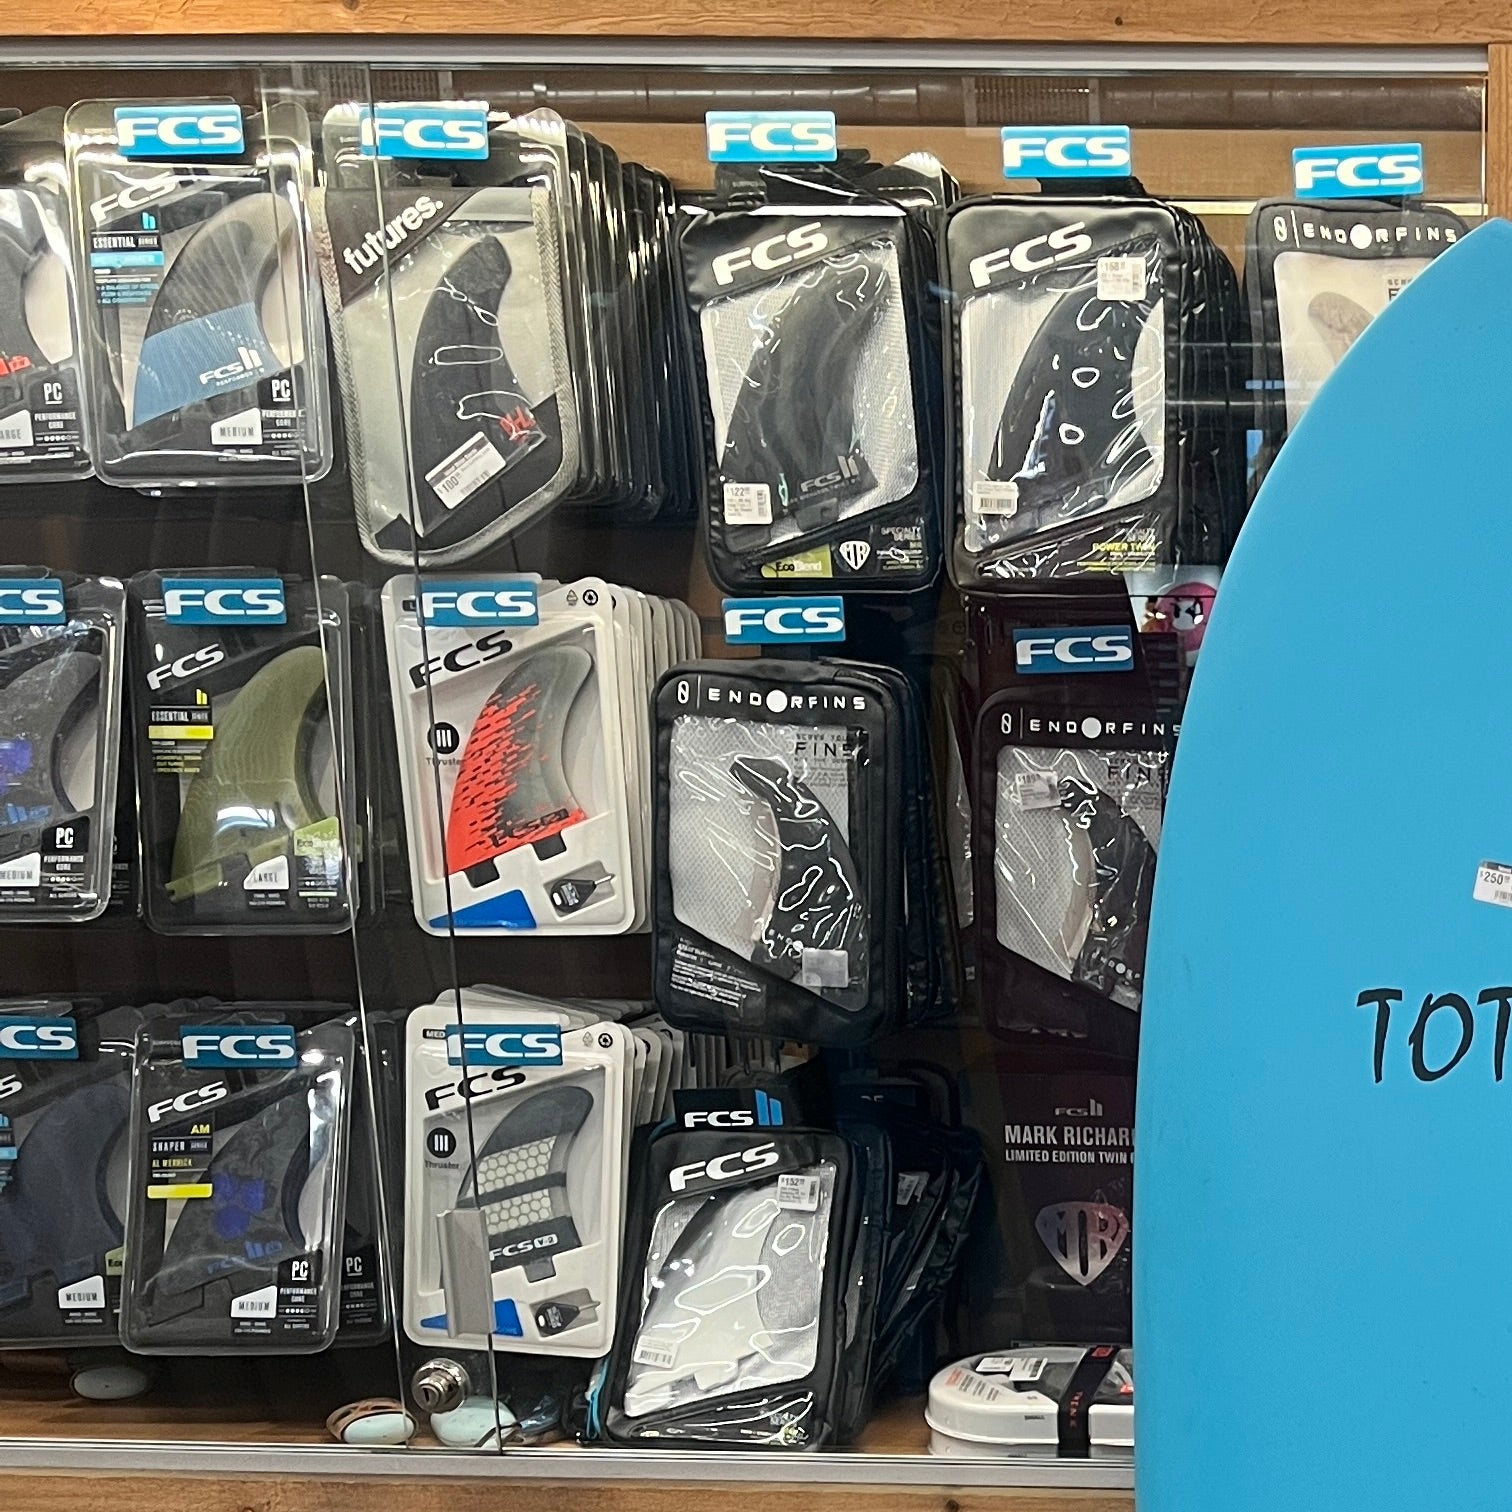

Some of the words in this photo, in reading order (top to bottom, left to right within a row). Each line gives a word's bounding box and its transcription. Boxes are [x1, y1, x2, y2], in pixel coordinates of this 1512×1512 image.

[116, 116, 242, 147] FCS
[361, 118, 487, 149] FCS
[708, 122, 834, 152] FCS
[1003, 137, 1130, 167] FCS
[1295, 154, 1422, 189] FCS
[90, 171, 177, 224] FCS
[343, 194, 444, 276] futures.
[710, 221, 830, 287] FCS
[970, 222, 1092, 288] FCS
[200, 363, 243, 385] FCS
[43, 383, 63, 400] PC
[271, 379, 291, 399] PC
[219, 426, 255, 437] MEDIUM
[0, 589, 63, 615] CS
[164, 588, 284, 616] FCS
[422, 590, 536, 618] FCS
[724, 606, 844, 634] FCS
[409, 630, 513, 689] FCS
[1016, 635, 1133, 665] FCS
[146, 643, 225, 690] FCS
[55, 827, 74, 847] PC
[0, 1025, 76, 1051] CS
[182, 1034, 296, 1060] FCS
[448, 1033, 561, 1058] FCS
[147, 1080, 228, 1124] FCS
[424, 1067, 526, 1111] FCS
[190, 1124, 211, 1134] AM
[684, 1110, 754, 1128] FCS
[152, 1140, 185, 1152] SHAPER
[1005, 1125, 1058, 1146] MARK
[669, 1143, 779, 1192] FCS
[1005, 1150, 1050, 1163] LIMITED
[1052, 1150, 1095, 1164] EDITION
[1098, 1151, 1128, 1164] TWIN
[489, 1241, 533, 1261] FCS
[291, 1261, 308, 1279] PC
[346, 1256, 362, 1274] PC
[66, 1291, 98, 1303] MEDIUM
[238, 1300, 271, 1311] MEDIUM
